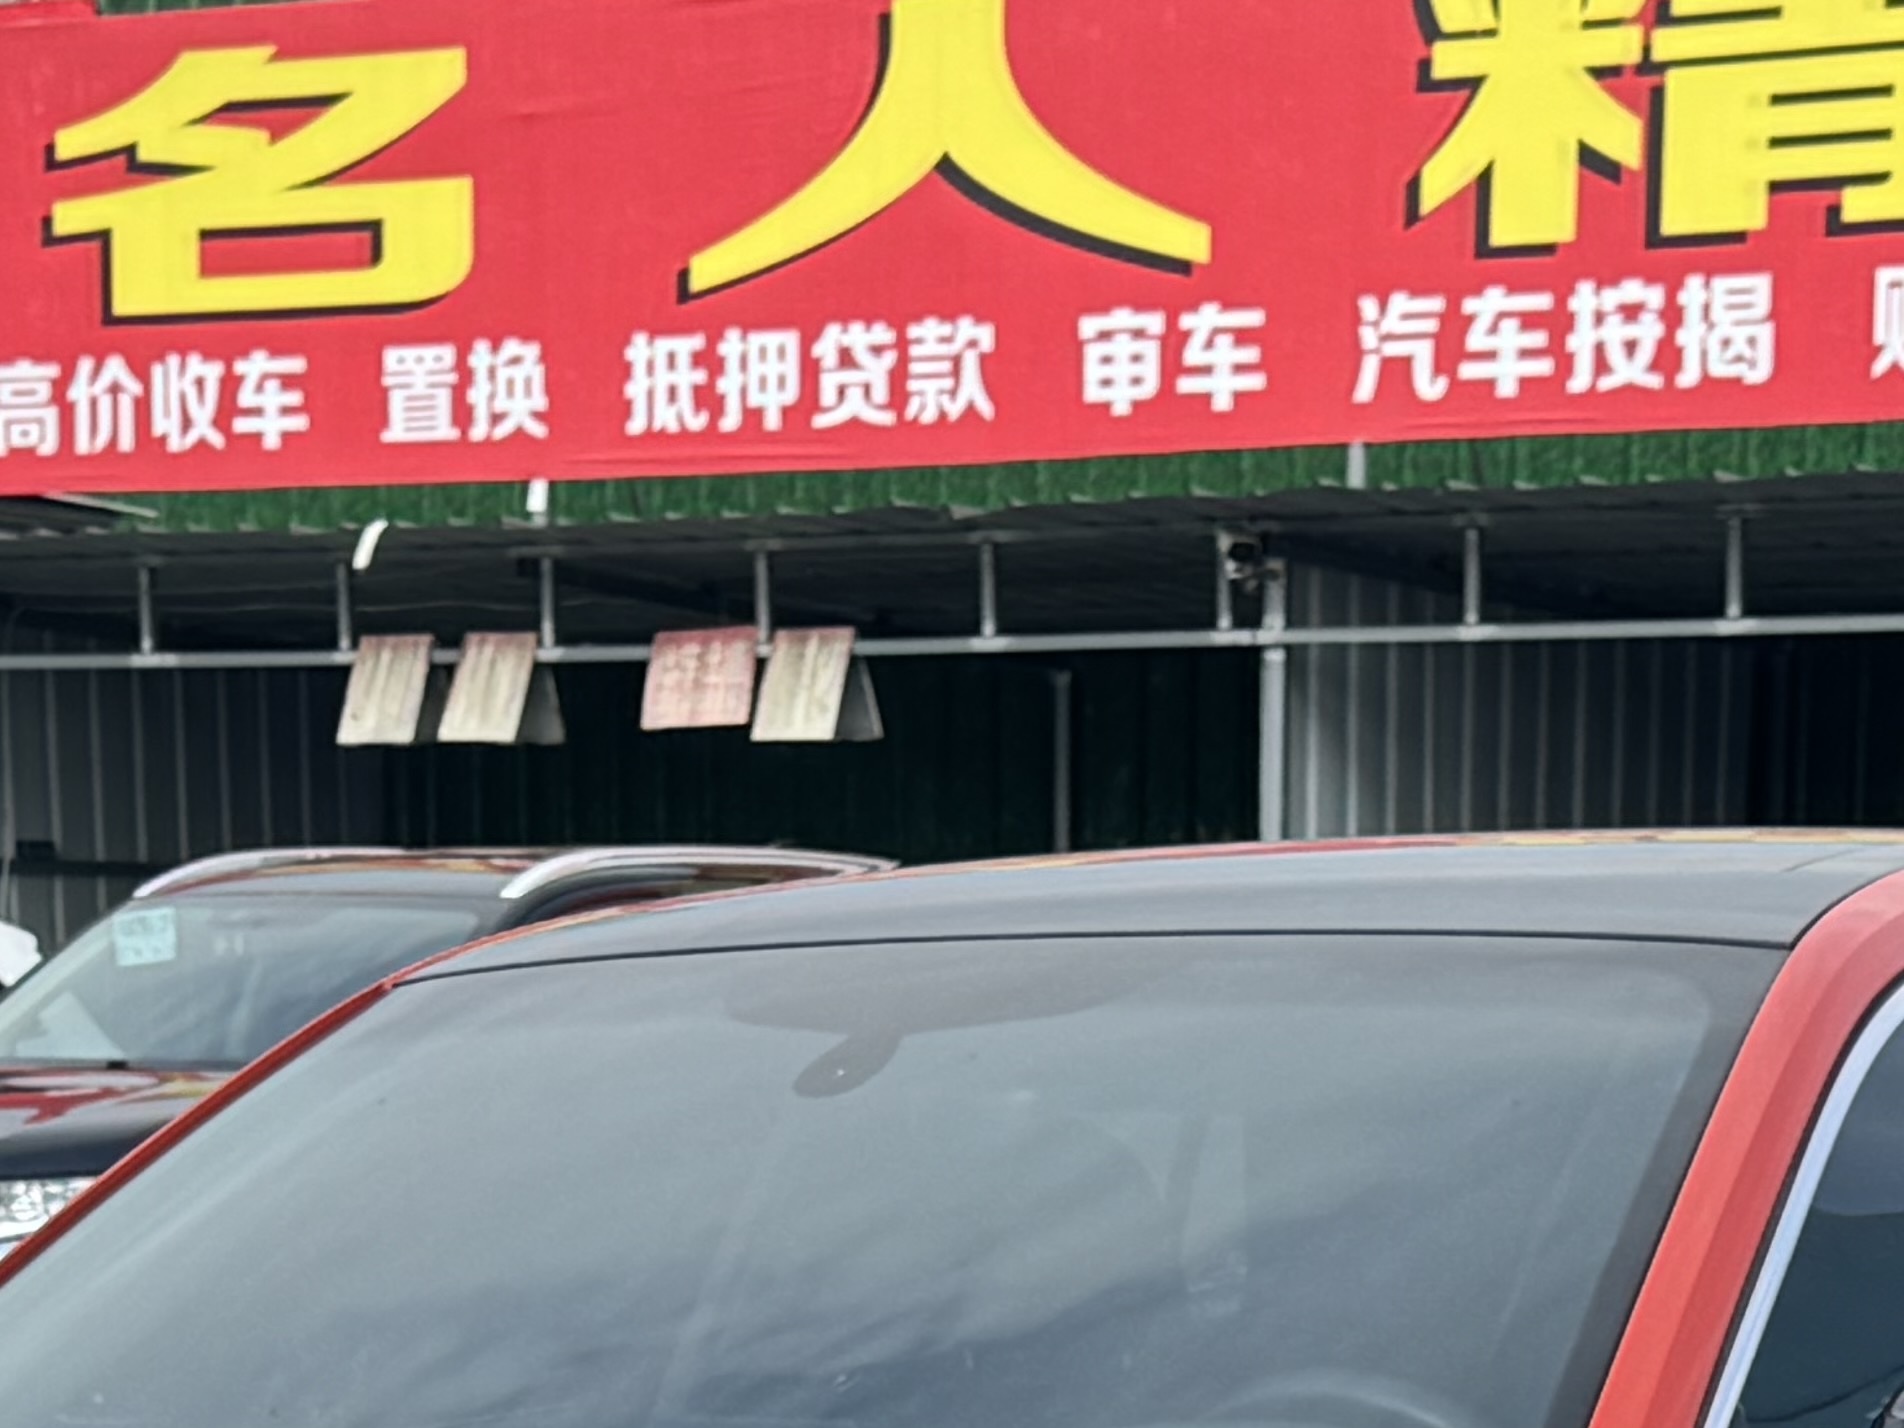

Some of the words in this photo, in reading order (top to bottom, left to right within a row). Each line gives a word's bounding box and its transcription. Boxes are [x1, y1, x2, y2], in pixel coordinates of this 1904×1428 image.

[380, 337, 549, 445] 置换
[623, 315, 996, 435] 抵押贷款
[1078, 301, 1267, 417] 审车
[1351, 271, 1775, 404] 汽车按揭
